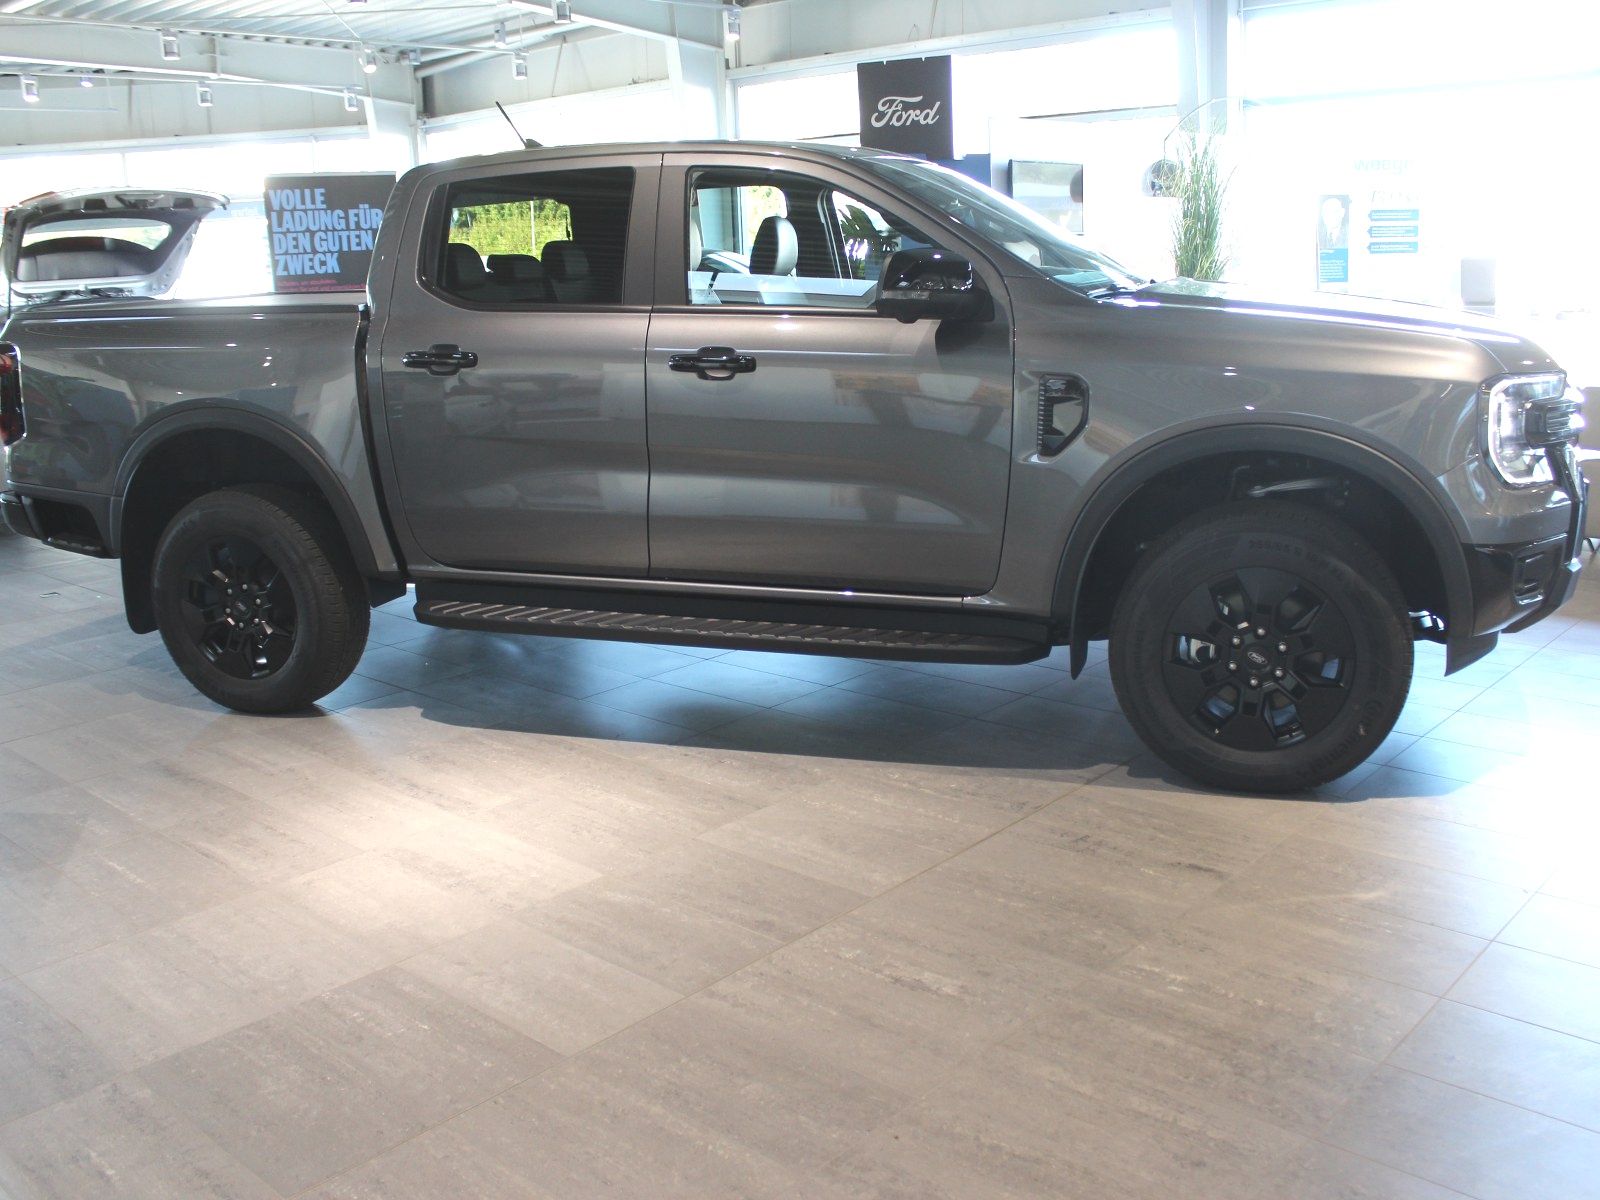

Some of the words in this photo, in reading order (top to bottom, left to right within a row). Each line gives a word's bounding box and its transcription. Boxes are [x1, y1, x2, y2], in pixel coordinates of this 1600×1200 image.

[870, 95, 941, 128] Ford
[268, 188, 326, 210] VOLLE
[271, 209, 347, 232] LADUNG
[348, 203, 384, 229] FÜR
[273, 232, 311, 254] DEN
[314, 230, 373, 252] GUTEN
[275, 253, 340, 276] ZWECK
